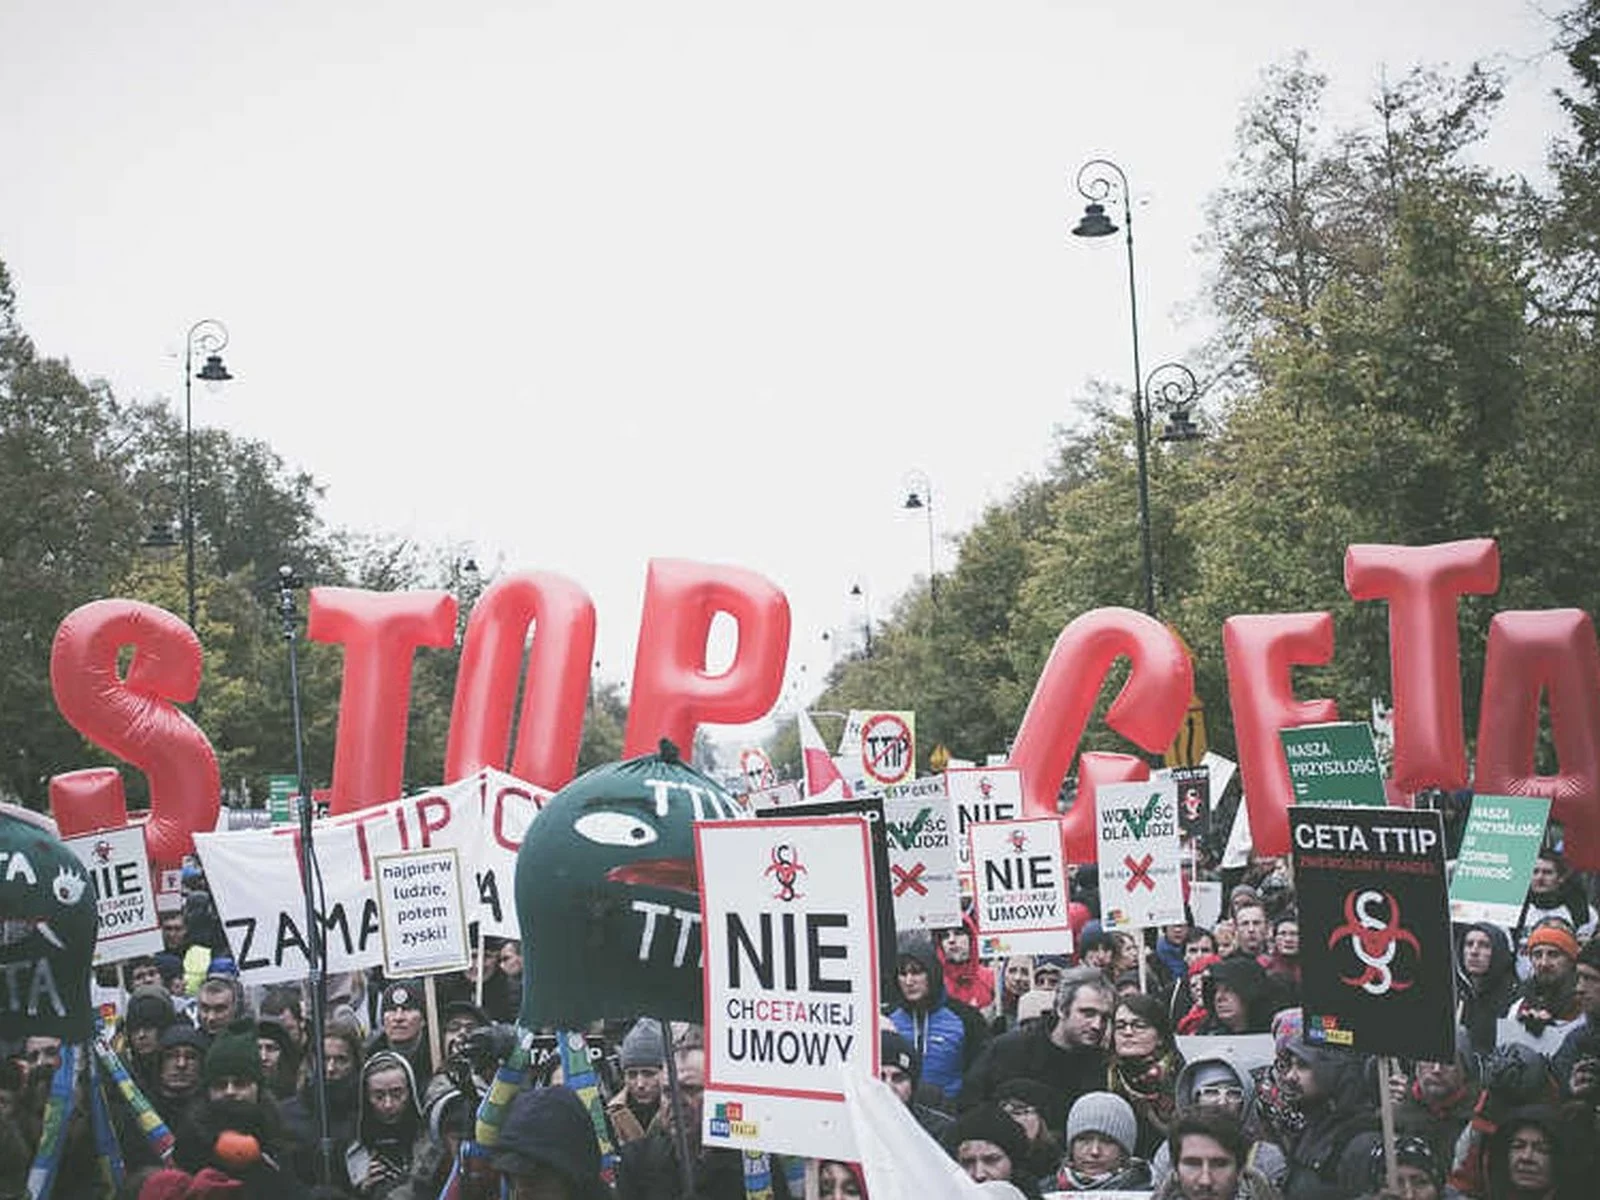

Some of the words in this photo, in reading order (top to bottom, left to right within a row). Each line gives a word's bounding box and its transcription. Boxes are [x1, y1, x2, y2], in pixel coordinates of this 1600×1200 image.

[49, 557, 791, 868] STOP
[1008, 538, 1600, 872] CETA
[1286, 742, 1331, 757] NASZA
[1292, 756, 1376, 776] PRZYSZŁOŚĆ
[1295, 823, 1369, 851] CETA
[1371, 827, 1436, 855] TTIP
[383, 860, 452, 880] najpierw
[985, 855, 1055, 892] NIE
[397, 906, 447, 925] potem
[988, 904, 1056, 921] UMOWY
[401, 926, 448, 947] zyski!
[632, 901, 704, 968] TT
[725, 912, 852, 993] NIE
[727, 998, 854, 1026] CHCETAKIEJ
[727, 1027, 854, 1067] UMOWY
